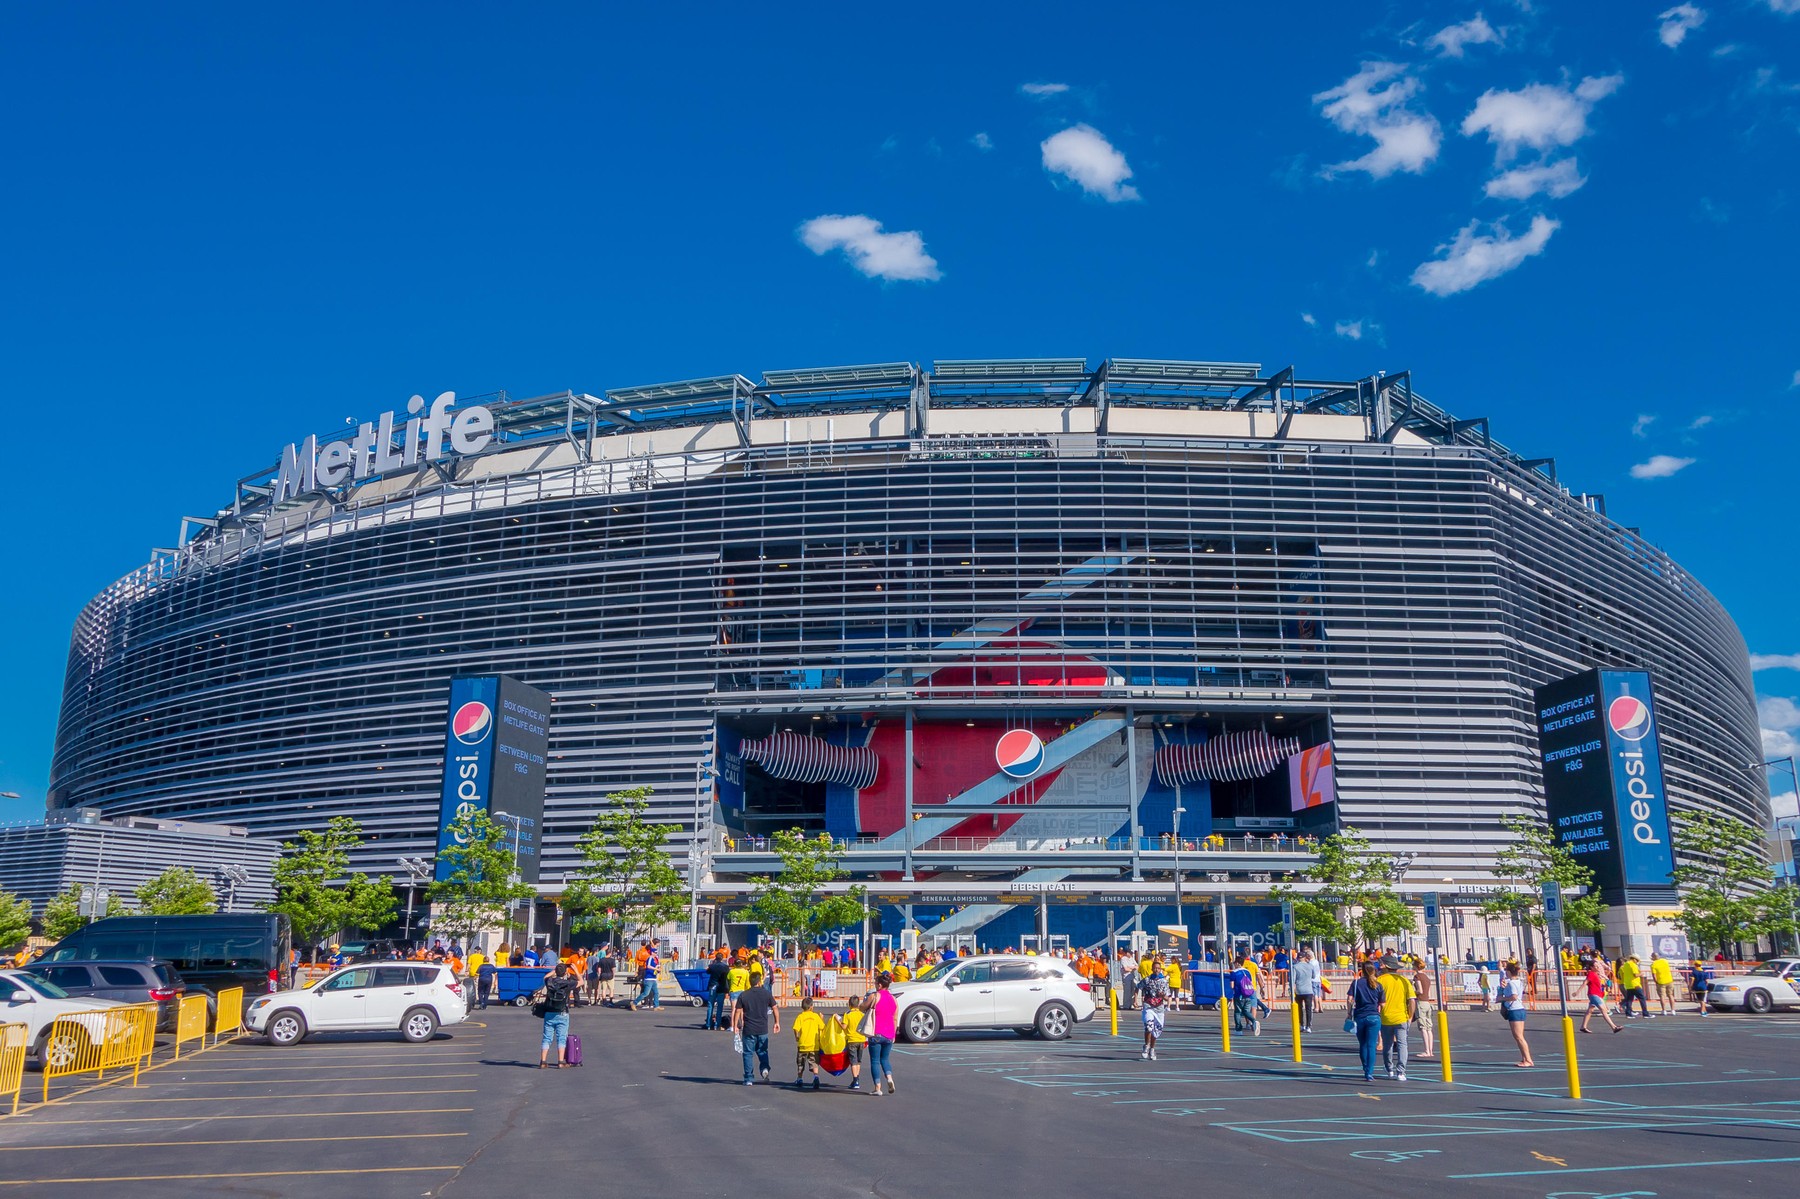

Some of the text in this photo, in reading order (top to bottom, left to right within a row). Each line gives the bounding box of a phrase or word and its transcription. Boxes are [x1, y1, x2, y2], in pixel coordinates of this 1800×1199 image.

[273, 391, 494, 502] MetLife
[503, 699, 546, 723] BOX OFFICE AT
[1541, 694, 1595, 719] BOX OFFICE AT
[503, 714, 545, 736] METLIFE GATE
[1543, 710, 1595, 733] METLIFE GATE
[499, 743, 544, 765] BETWEEN LOTS
[1545, 740, 1602, 762] BETWEEN LOTS
[514, 762, 528, 775] F&G
[1565, 759, 1583, 773] F&G
[724, 772, 741, 786] CALL
[1619, 751, 1661, 845] pepsi
[1559, 811, 1603, 826] NO TICKETS
[1562, 826, 1604, 841] AVAILABLE
[519, 845, 535, 856] GATE
[1588, 840, 1610, 852] GATE
[736, 976, 743, 987] 7
